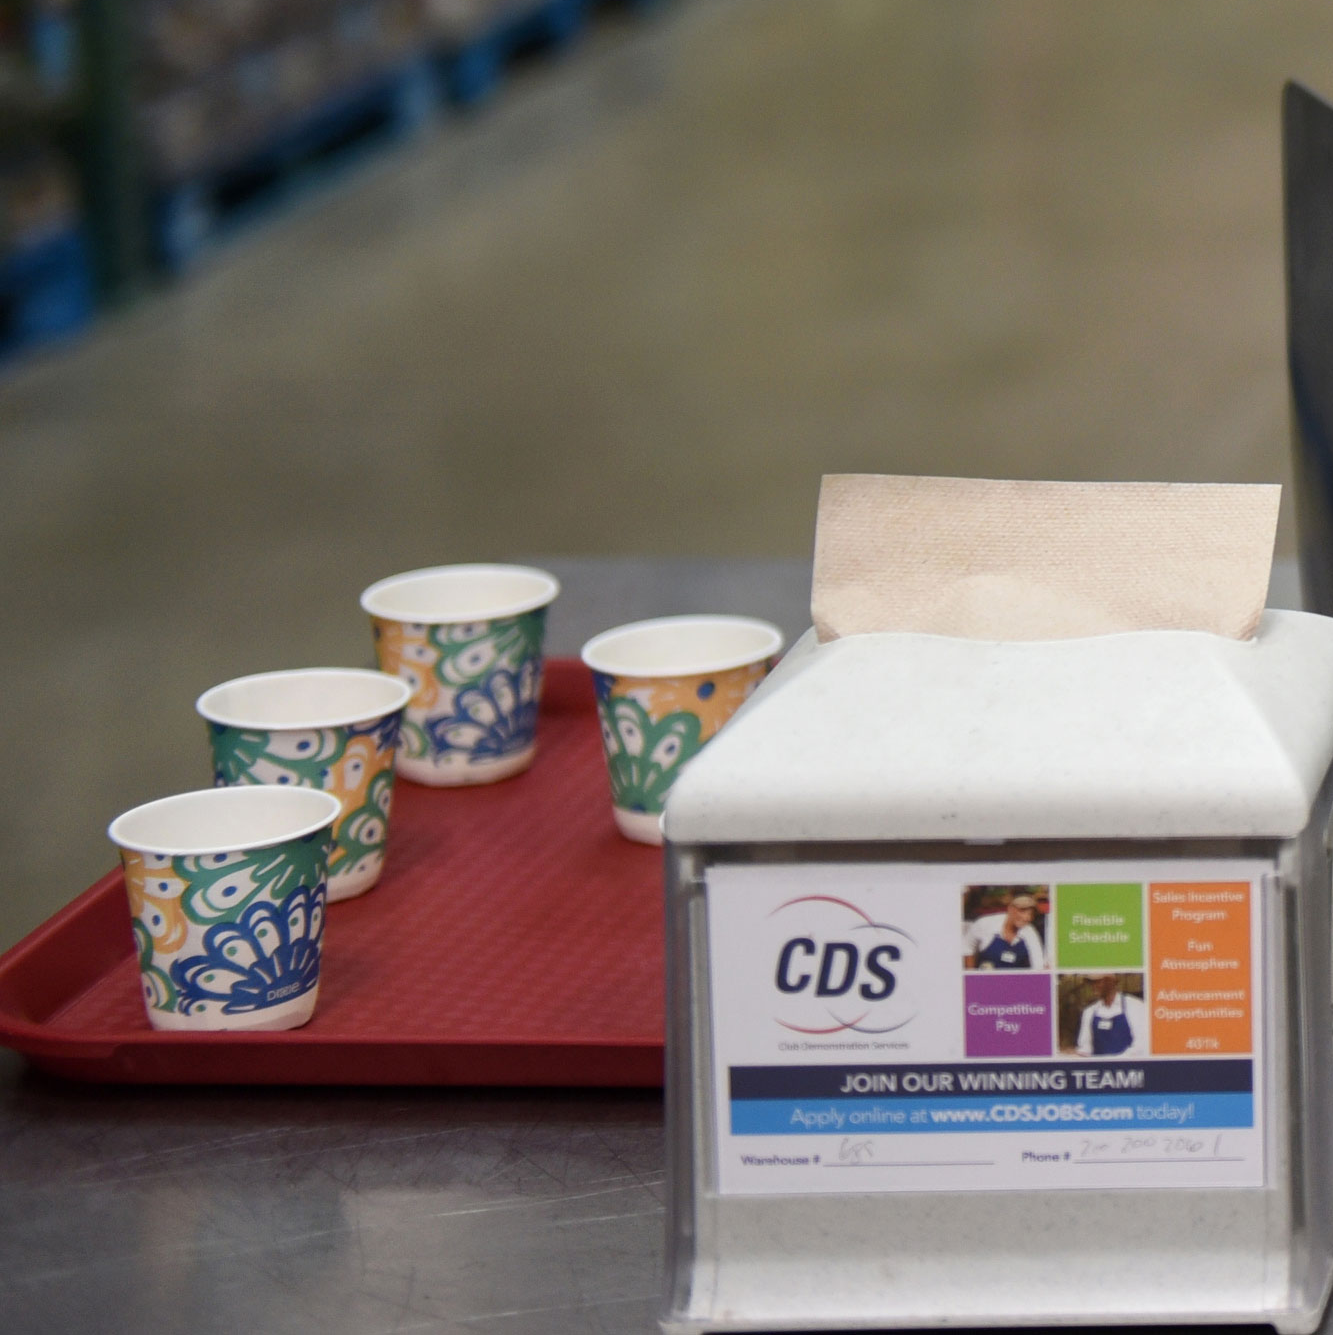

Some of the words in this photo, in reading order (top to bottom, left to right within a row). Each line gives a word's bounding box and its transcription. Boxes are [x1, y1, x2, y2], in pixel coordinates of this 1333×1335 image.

[1152, 891, 1187, 903] Sales
[1188, 890, 1244, 903] Incentive
[1072, 913, 1125, 926] Flexible
[1172, 909, 1228, 923] Program
[1068, 930, 1130, 943] Schedule
[1187, 940, 1213, 952] Fun
[775, 937, 902, 1002] CDS
[1160, 959, 1240, 972] Atmosphere
[1156, 990, 1245, 1002] Advancement
[968, 1003, 1046, 1017] Competitive
[1154, 1007, 1244, 1022] Opportunities
[995, 1019, 1020, 1035] Pay
[840, 1073, 898, 1093] JOIN
[902, 1072, 954, 1092] OUR
[957, 1071, 1068, 1092] WINNING
[1071, 1068, 1145, 1089] TEAM!
[789, 1107, 845, 1129] Apply
[848, 1108, 904, 1124] online
[910, 1108, 928, 1124] at
[930, 1102, 1134, 1123] www.CDSJOBS.com
[1136, 1102, 1195, 1125] today!
[740, 1154, 809, 1165] Warehouse
[1021, 1151, 1060, 1163] Phone
